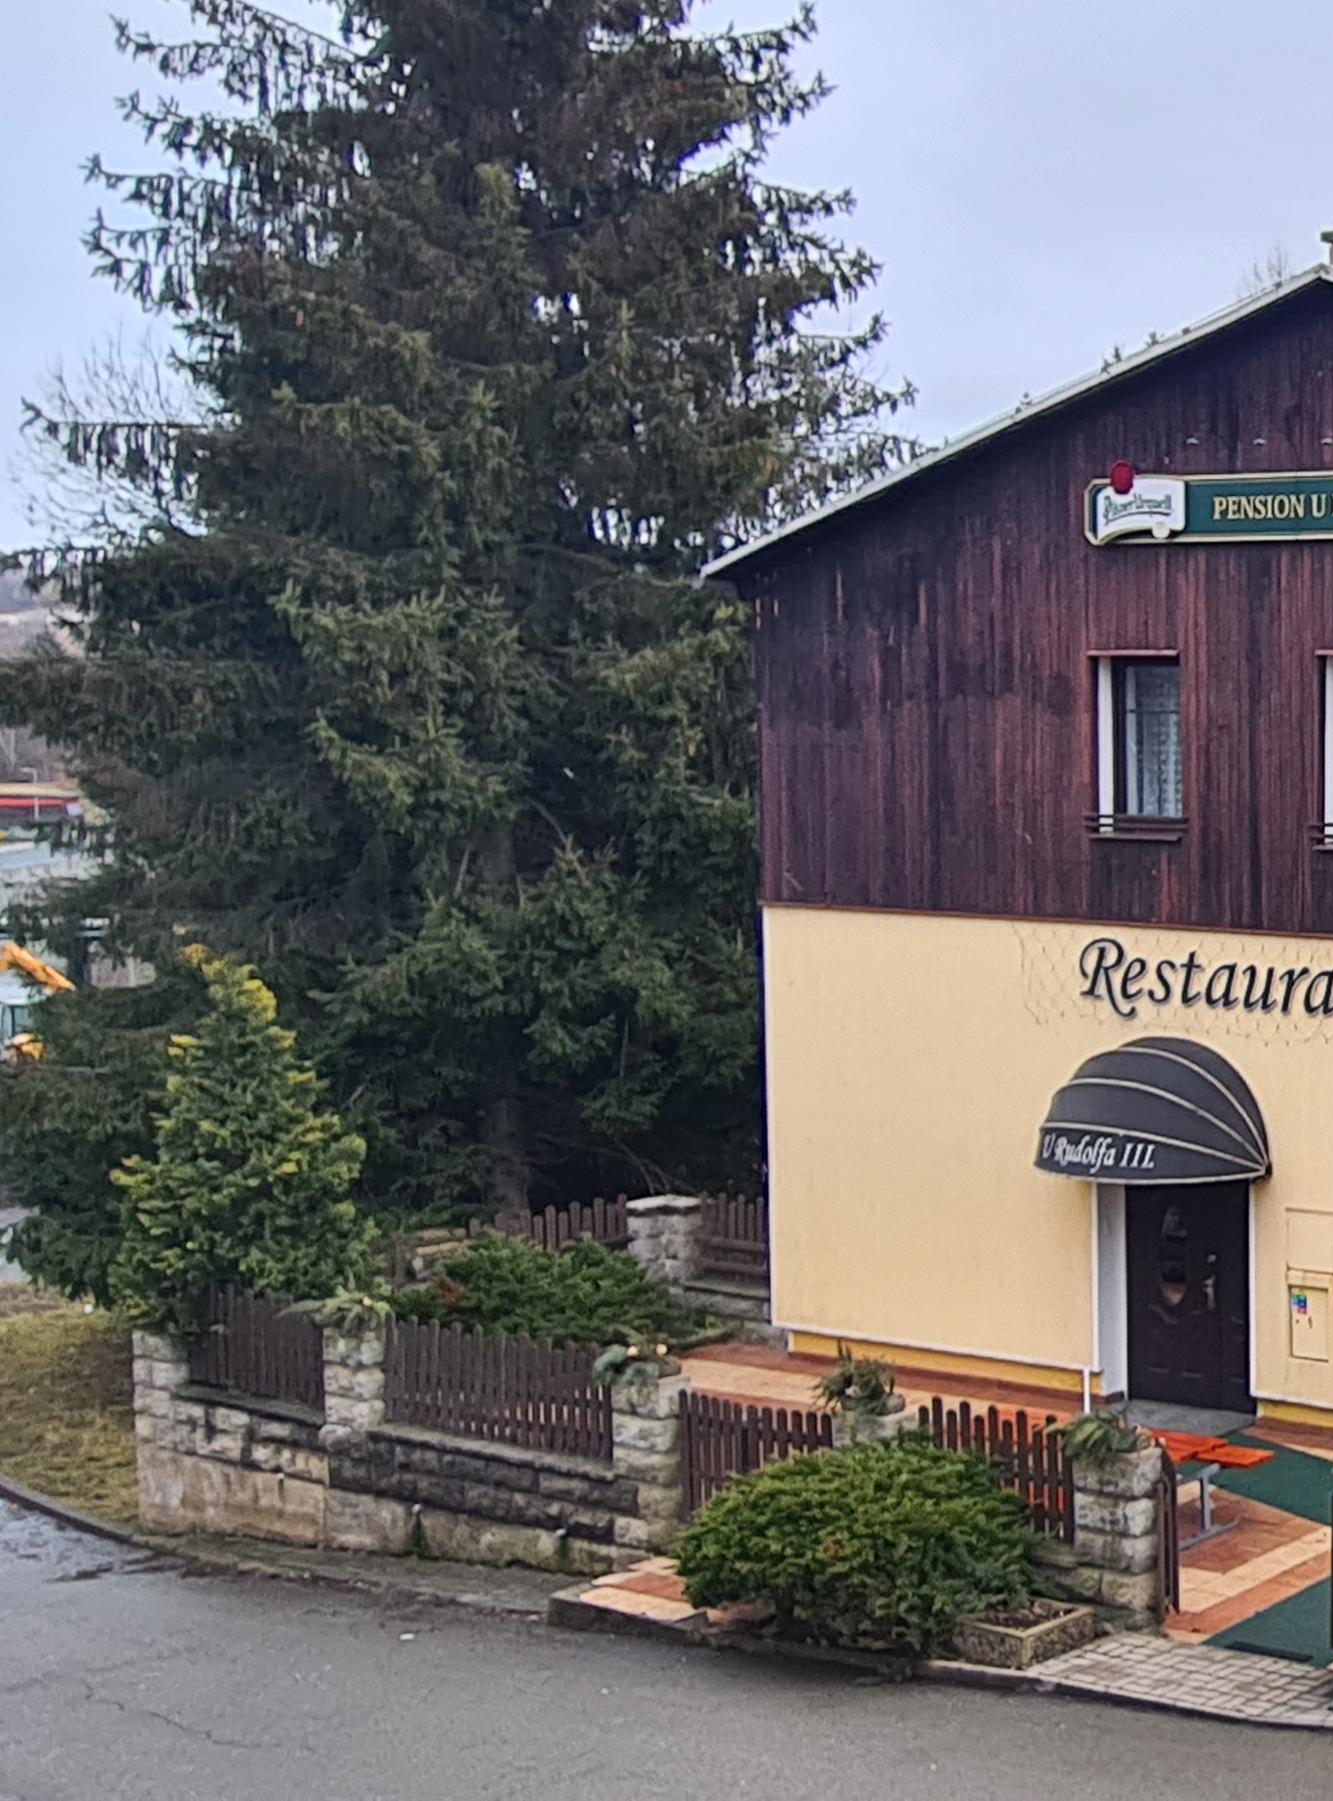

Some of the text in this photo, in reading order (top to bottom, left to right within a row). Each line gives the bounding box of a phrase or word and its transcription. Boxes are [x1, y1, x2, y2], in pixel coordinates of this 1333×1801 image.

[1212, 493, 1306, 521] PENSION
[1310, 492, 1327, 519] U
[1042, 1133, 1055, 1158] U
[1055, 1135, 1116, 1174] Rudolfa
